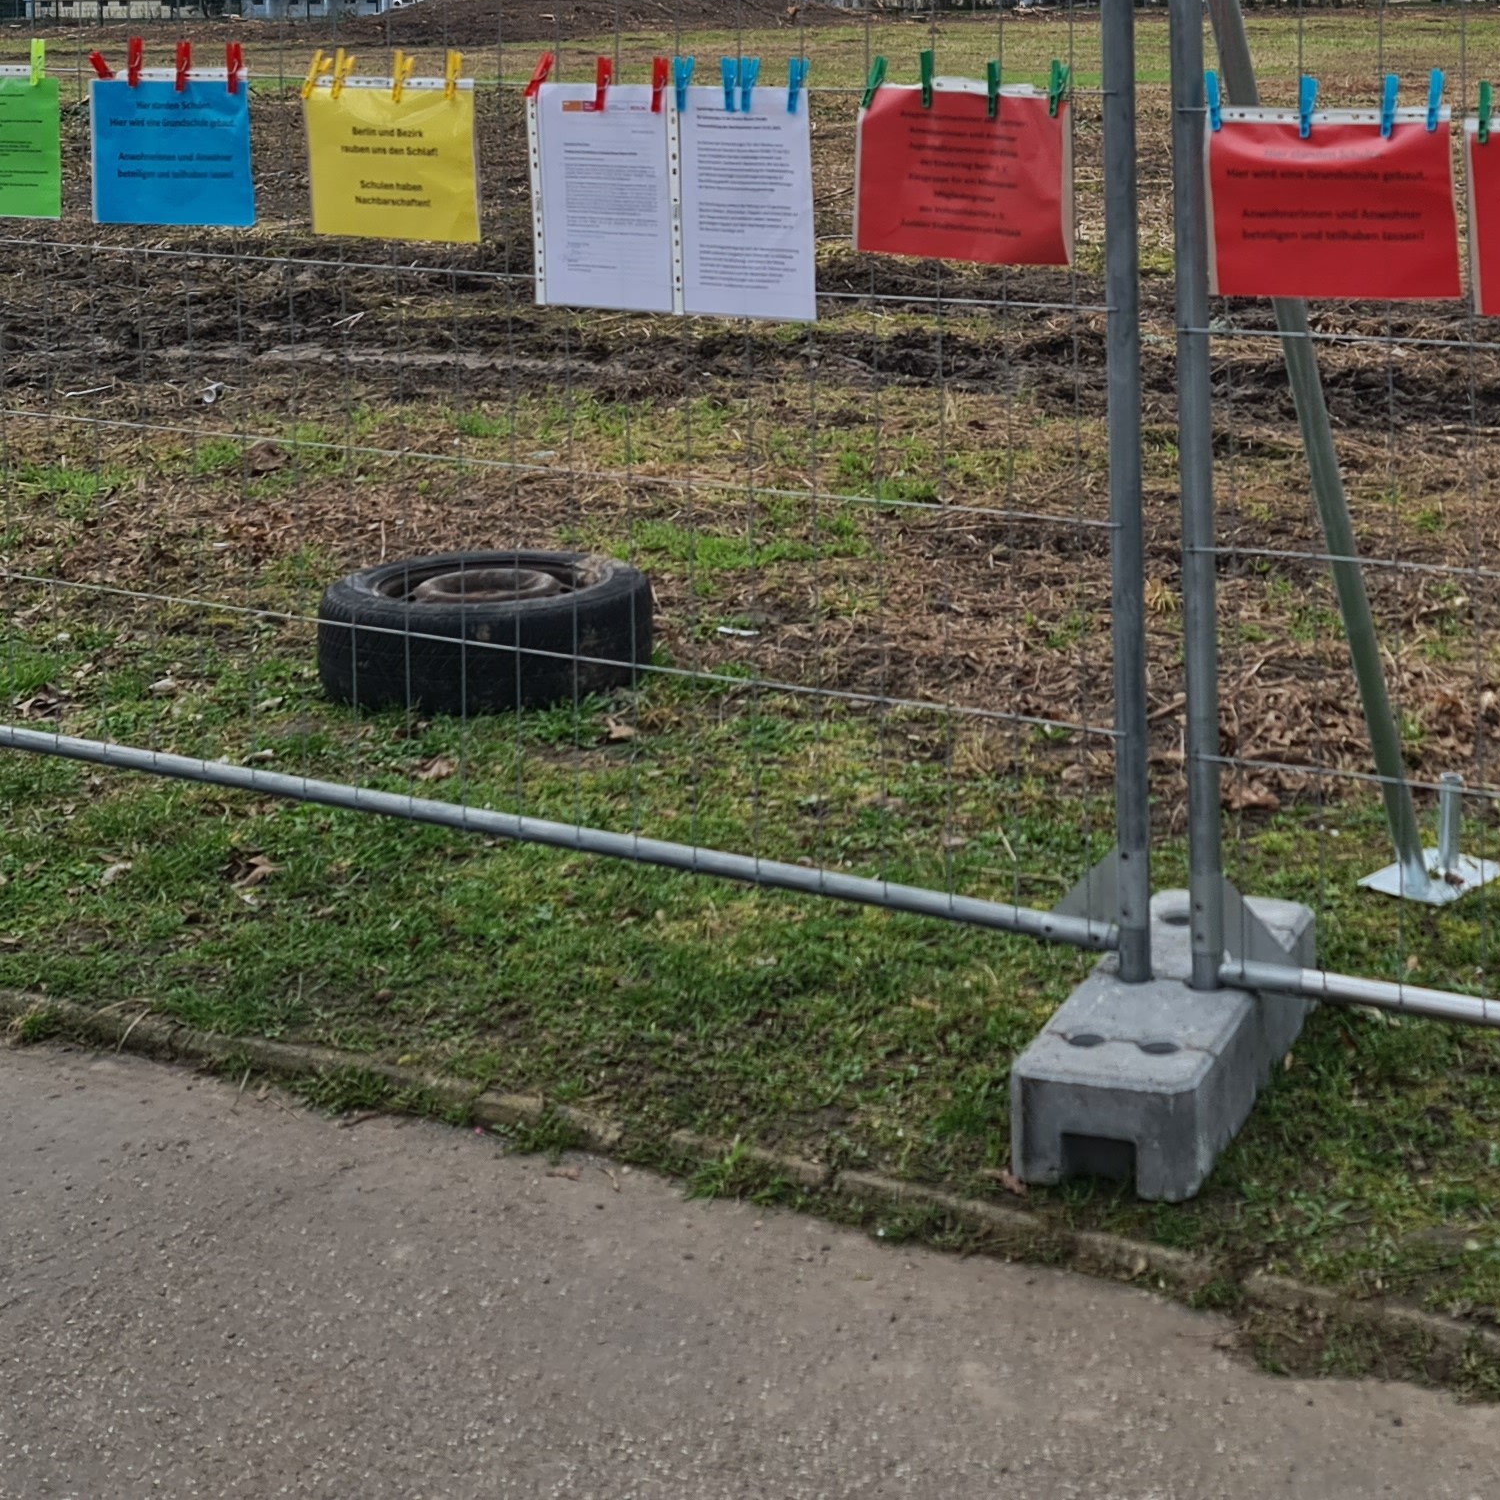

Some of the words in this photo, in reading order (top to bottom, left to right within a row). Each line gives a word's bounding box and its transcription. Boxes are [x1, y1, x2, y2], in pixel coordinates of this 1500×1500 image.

[352, 126, 377, 136] Berlin
[378, 128, 395, 137] und
[396, 128, 423, 138] Bezirk
[371, 147, 387, 155] uns
[388, 146, 405, 155] den
[1226, 169, 1249, 179] Hier
[1251, 168, 1277, 180] wird
[360, 179, 394, 190] Schulen
[396, 182, 423, 192] haben
[1335, 208, 1359, 220] und
